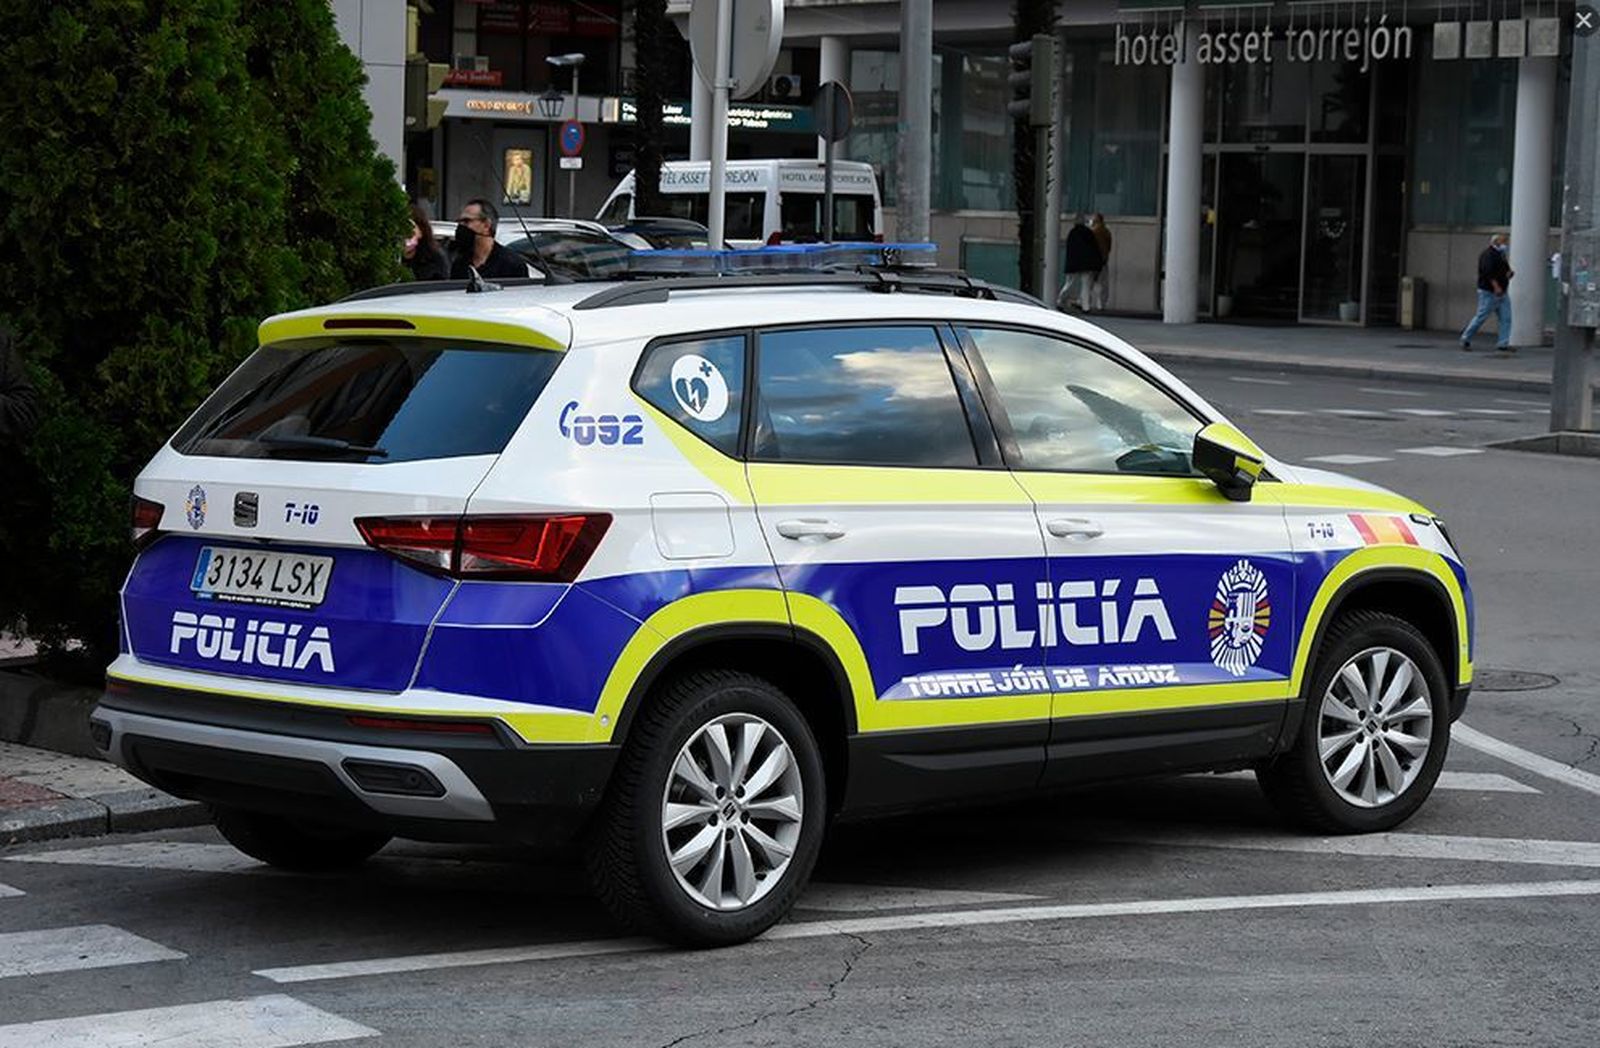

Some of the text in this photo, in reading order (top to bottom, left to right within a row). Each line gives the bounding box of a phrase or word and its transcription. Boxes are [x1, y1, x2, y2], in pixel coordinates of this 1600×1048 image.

[1115, 14, 1412, 73] hotel asset torrejón
[573, 414, 644, 446] 092
[208, 554, 324, 597] 3134 LSX
[894, 578, 1177, 654] POLICÍA
[170, 611, 335, 673] POLICÍA
[901, 664, 1181, 697] TORREJÓN DE ARDOZ
